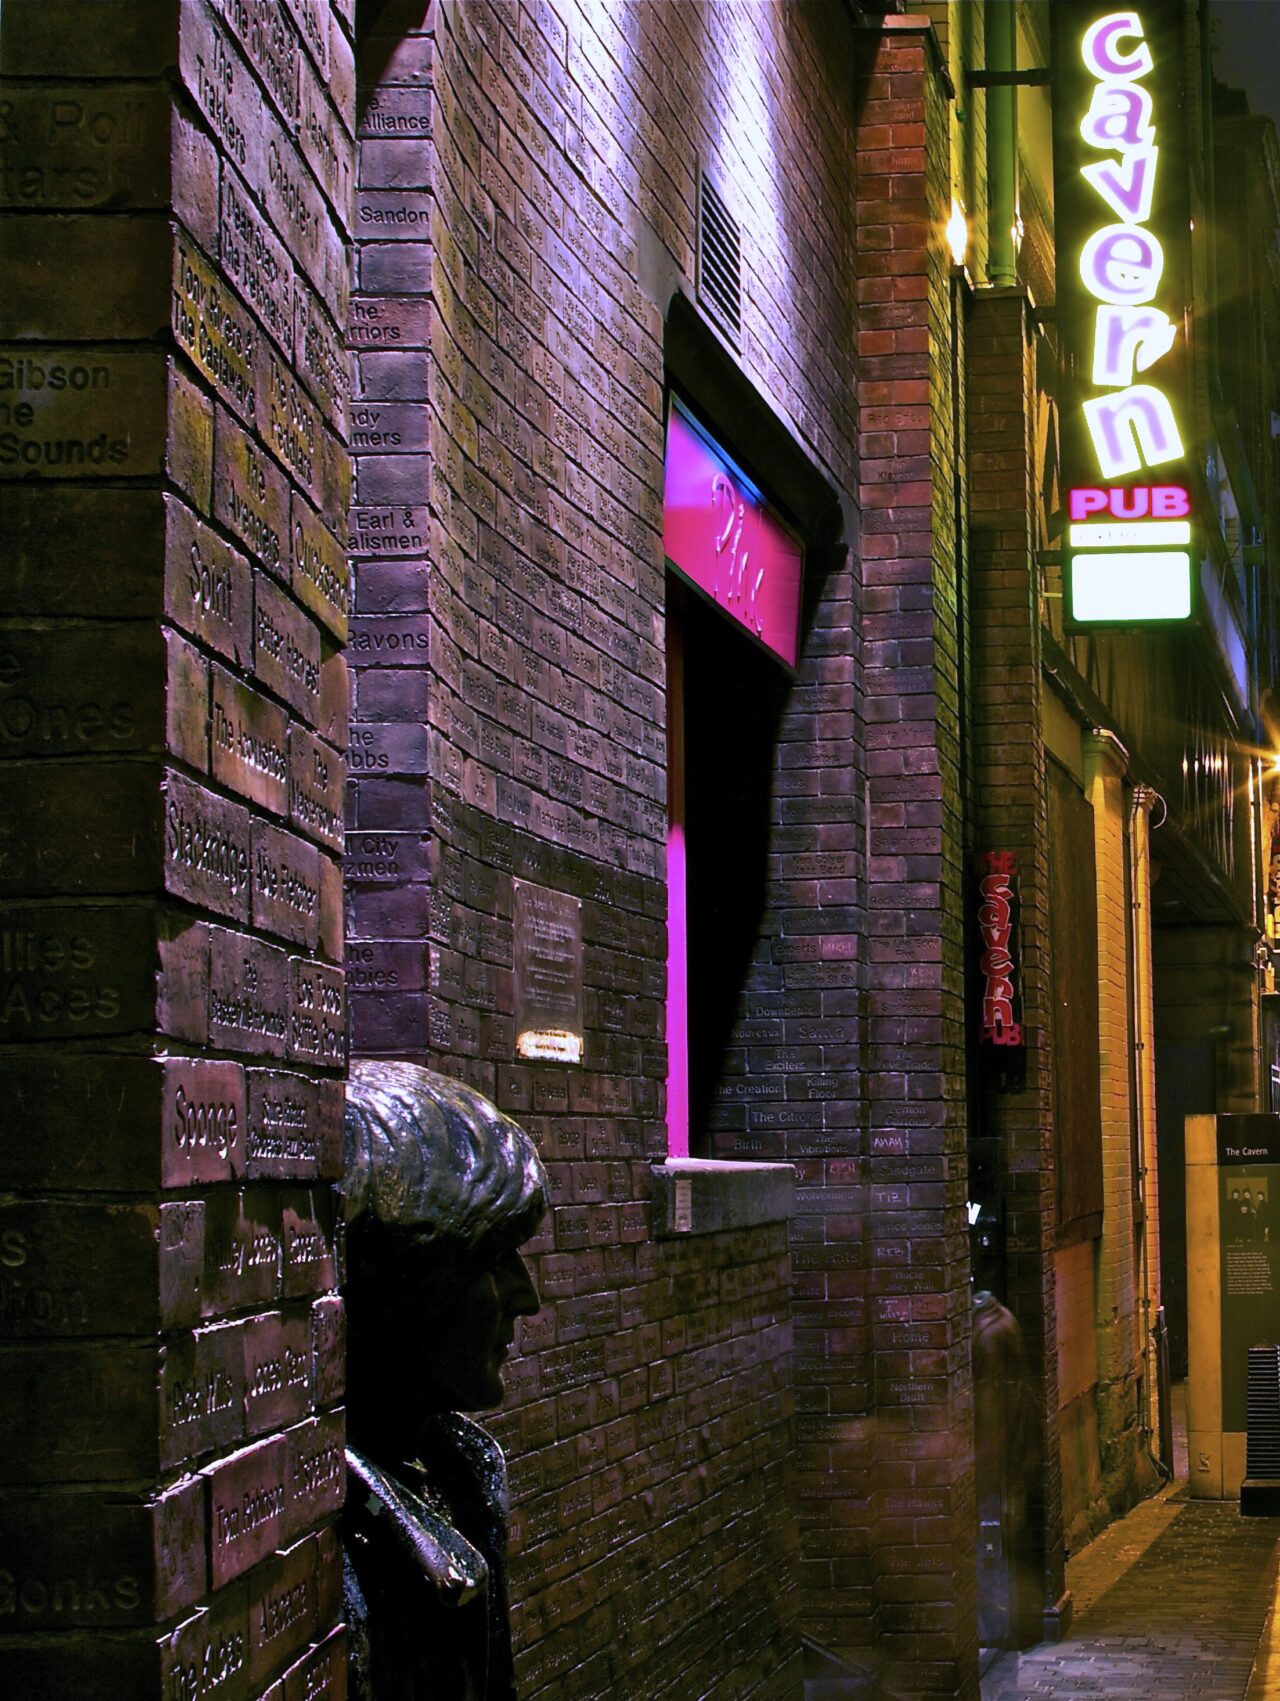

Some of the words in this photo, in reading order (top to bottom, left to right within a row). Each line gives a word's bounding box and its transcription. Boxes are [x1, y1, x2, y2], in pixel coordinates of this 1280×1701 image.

[213, 25, 233, 95] The
[363, 114, 430, 130] Alliance
[0, 162, 98, 199] tars
[268, 140, 309, 233] Chapter
[361, 207, 429, 223] Sandon
[174, 290, 196, 349] The
[210, 285, 243, 355] Rivers
[354, 303, 378, 319] he
[349, 325, 400, 340] rriors
[0, 358, 110, 391] Gibson
[270, 353, 286, 415] The
[350, 409, 380, 428] ndy
[353, 431, 401, 446] mers
[0, 432, 129, 465] Sounds
[245, 443, 265, 503] The
[1070, 487, 1190, 520] PUB
[228, 480, 280, 568] Avengers
[357, 512, 394, 529] Earl
[403, 511, 415, 528] &
[349, 534, 422, 550] alismen
[188, 541, 234, 626] Spirit
[348, 629, 429, 651] Ravons
[215, 702, 235, 753] The
[236, 719, 287, 784] Acoustics
[349, 728, 374, 746] he
[346, 752, 390, 769] bbs
[313, 748, 328, 793] The
[168, 801, 248, 896] Stackridge
[362, 837, 398, 859] City
[345, 861, 399, 877] zmen
[821, 864, 845, 874] Band
[978, 852, 1016, 876] THE
[2, 930, 96, 972] llies
[345, 944, 374, 963] he
[978, 874, 1015, 1028] cavern
[0, 978, 120, 1023] Aces
[979, 1022, 1022, 1046] PUB
[777, 1050, 796, 1059] The
[765, 1061, 806, 1070] Exciters
[736, 1084, 781, 1095] Creation
[807, 1076, 839, 1088] Killing
[808, 1088, 837, 1099] Floor
[175, 1084, 238, 1160] Sponge
[752, 1111, 775, 1123] The
[779, 1111, 821, 1122] Citrons
[734, 1139, 762, 1151] Birth
[815, 1134, 834, 1143] The
[800, 1145, 849, 1154] Vibrations
[1225, 1147, 1240, 1157] The
[1242, 1146, 1268, 1157] Cavern
[879, 1164, 936, 1177] Sandgate
[795, 1251, 820, 1264] The
[892, 1331, 930, 1344] Home
[890, 1382, 934, 1393] Northern
[216, 1504, 240, 1547] Tom
